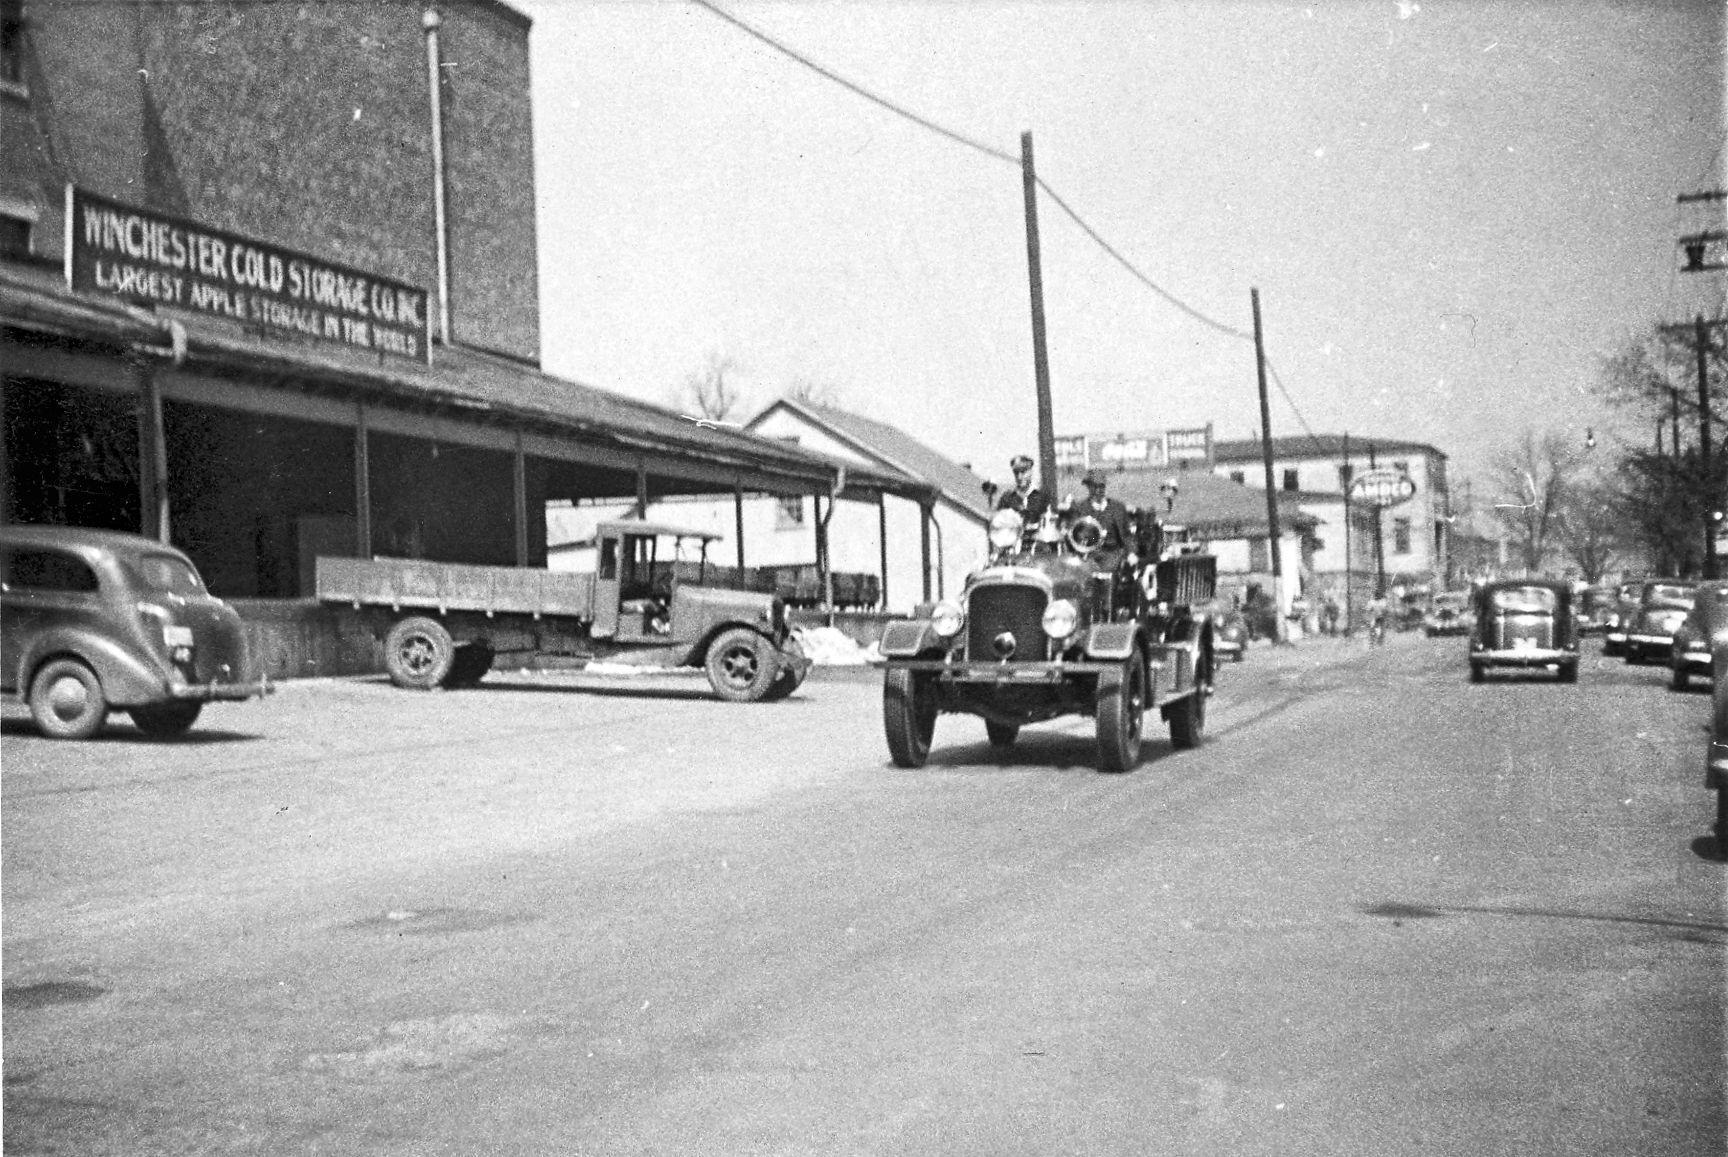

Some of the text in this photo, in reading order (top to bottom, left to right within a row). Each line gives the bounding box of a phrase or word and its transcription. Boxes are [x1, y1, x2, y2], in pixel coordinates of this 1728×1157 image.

[83, 205, 228, 279] WINCHESTER
[231, 242, 284, 294] COLD
[288, 258, 370, 317] STORAGE
[95, 260, 183, 303] LARGEST
[190, 283, 246, 318] APPLE
[251, 296, 319, 334] STORAGE
[323, 314, 340, 341] IN
[341, 317, 371, 347] THE
[1351, 481, 1412, 499] AMOCO
